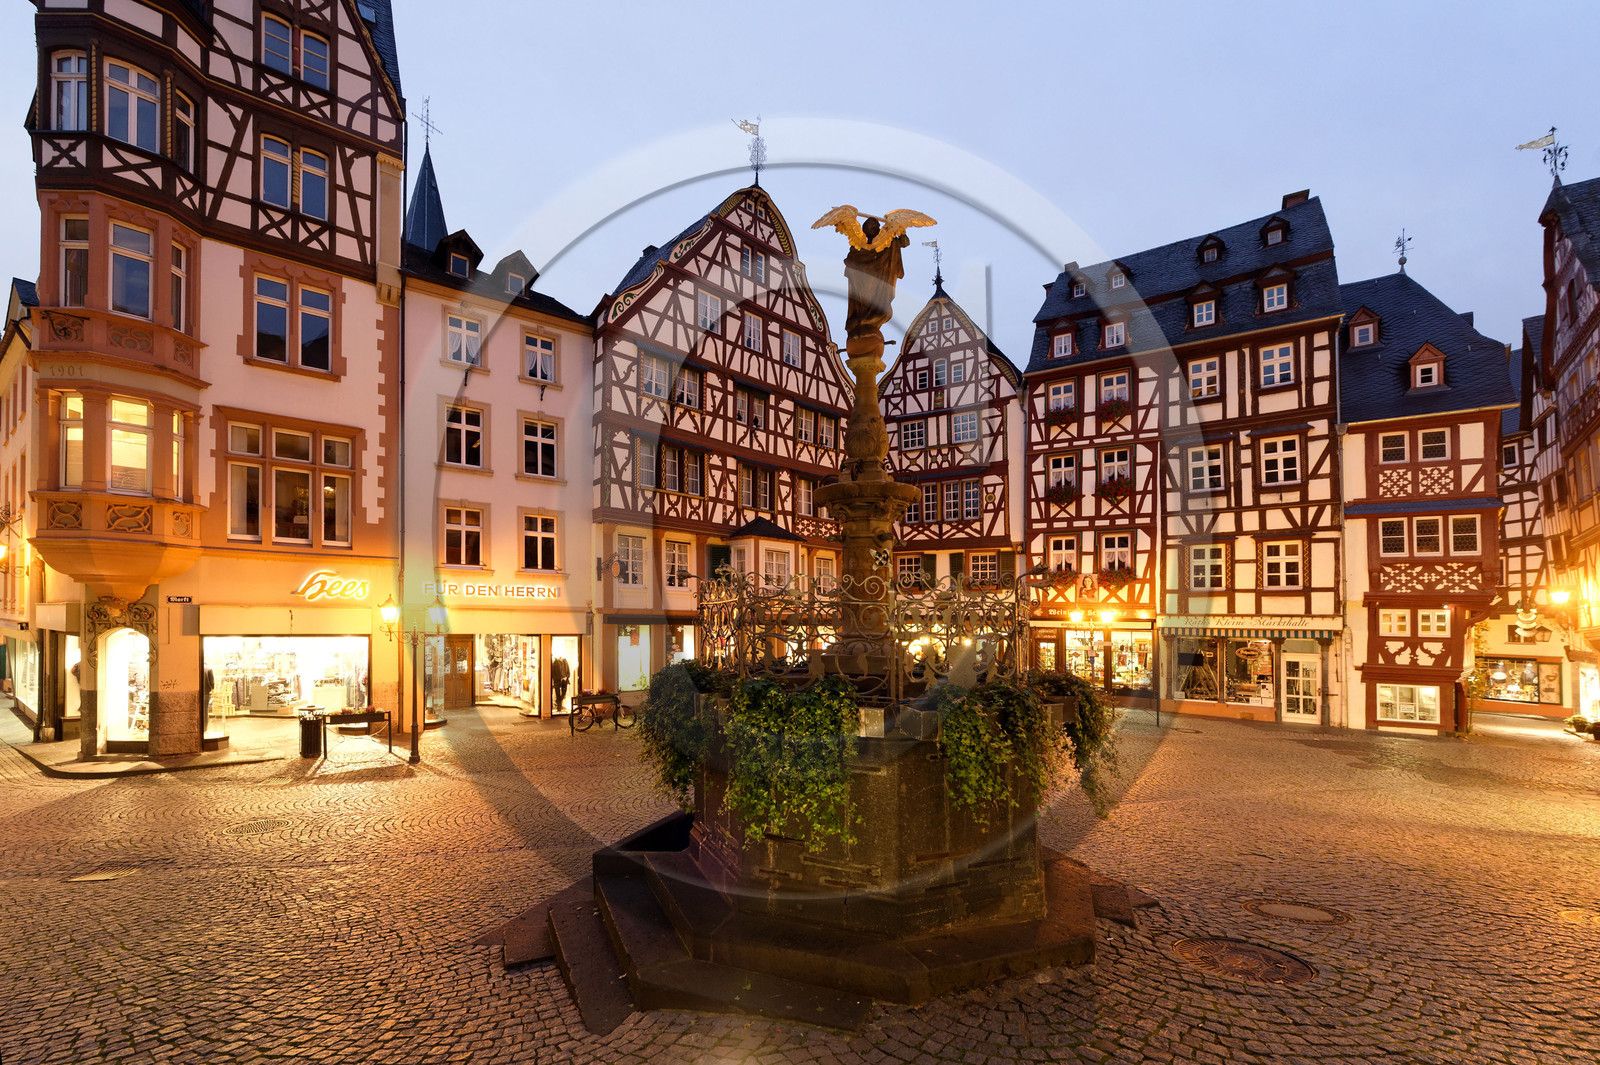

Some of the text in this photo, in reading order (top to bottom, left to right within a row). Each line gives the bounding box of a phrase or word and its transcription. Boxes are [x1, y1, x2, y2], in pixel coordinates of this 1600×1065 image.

[50, 365, 84, 377] 1901
[423, 579, 560, 599] FÜR DEN HERRN
